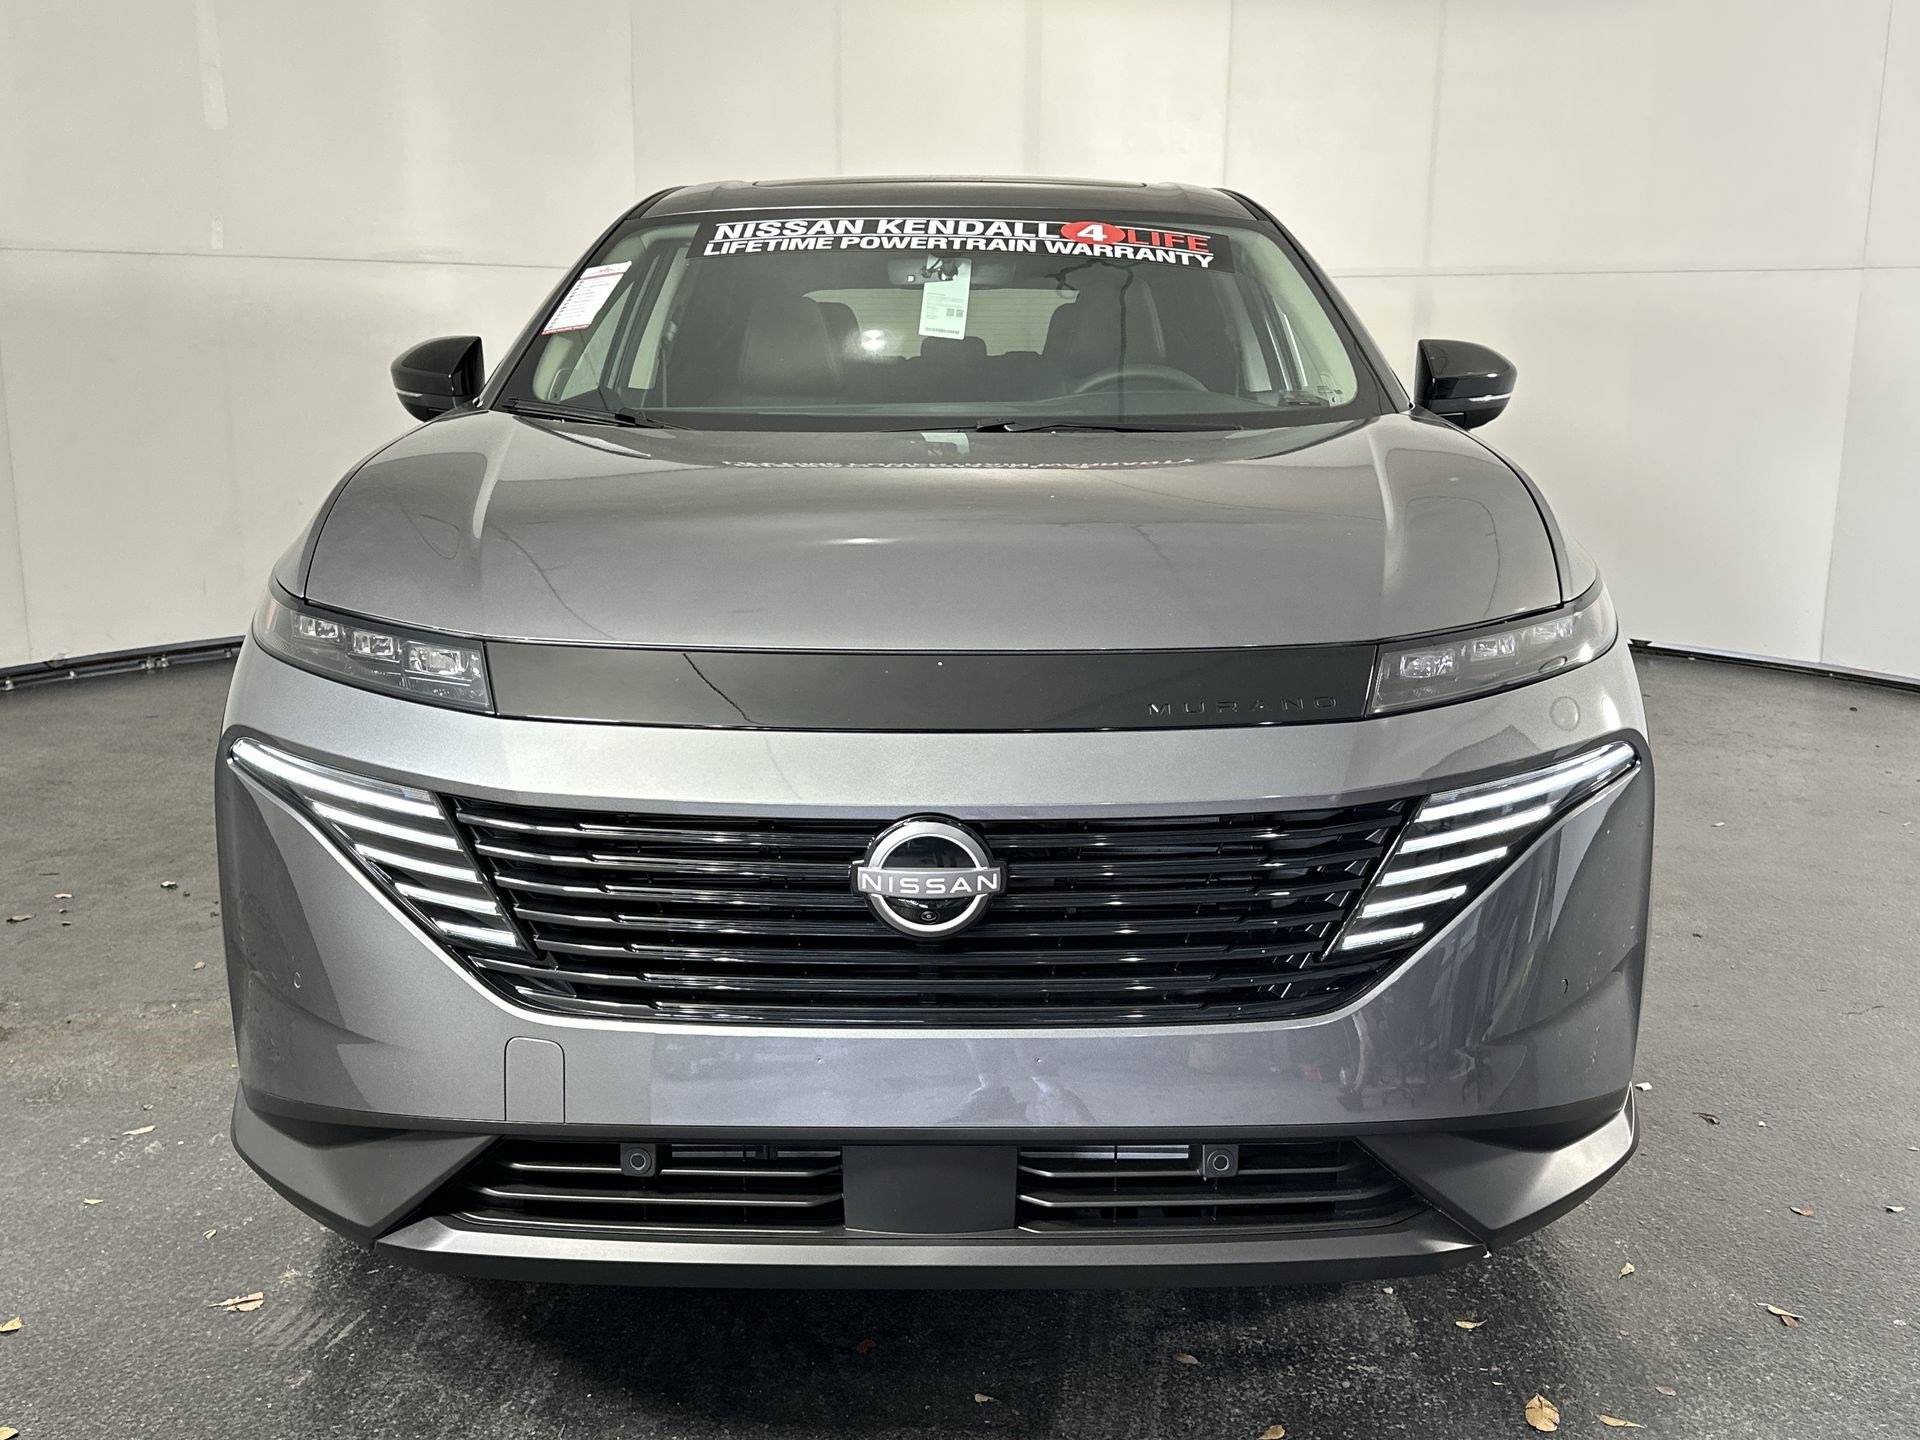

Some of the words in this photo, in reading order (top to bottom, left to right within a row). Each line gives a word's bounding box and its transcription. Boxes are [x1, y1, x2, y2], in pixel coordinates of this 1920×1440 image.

[714, 220, 864, 240] NISSAN
[876, 219, 1060, 239] KENDALL
[1076, 224, 1107, 242] 4
[1127, 229, 1210, 252] LIFE
[703, 237, 834, 255] LIFETIME
[840, 236, 1036, 252] POWERTRAIN
[1043, 240, 1215, 268] WARRANTY
[1148, 696, 1337, 716] MURANO
[861, 873, 997, 895] NISSAN
